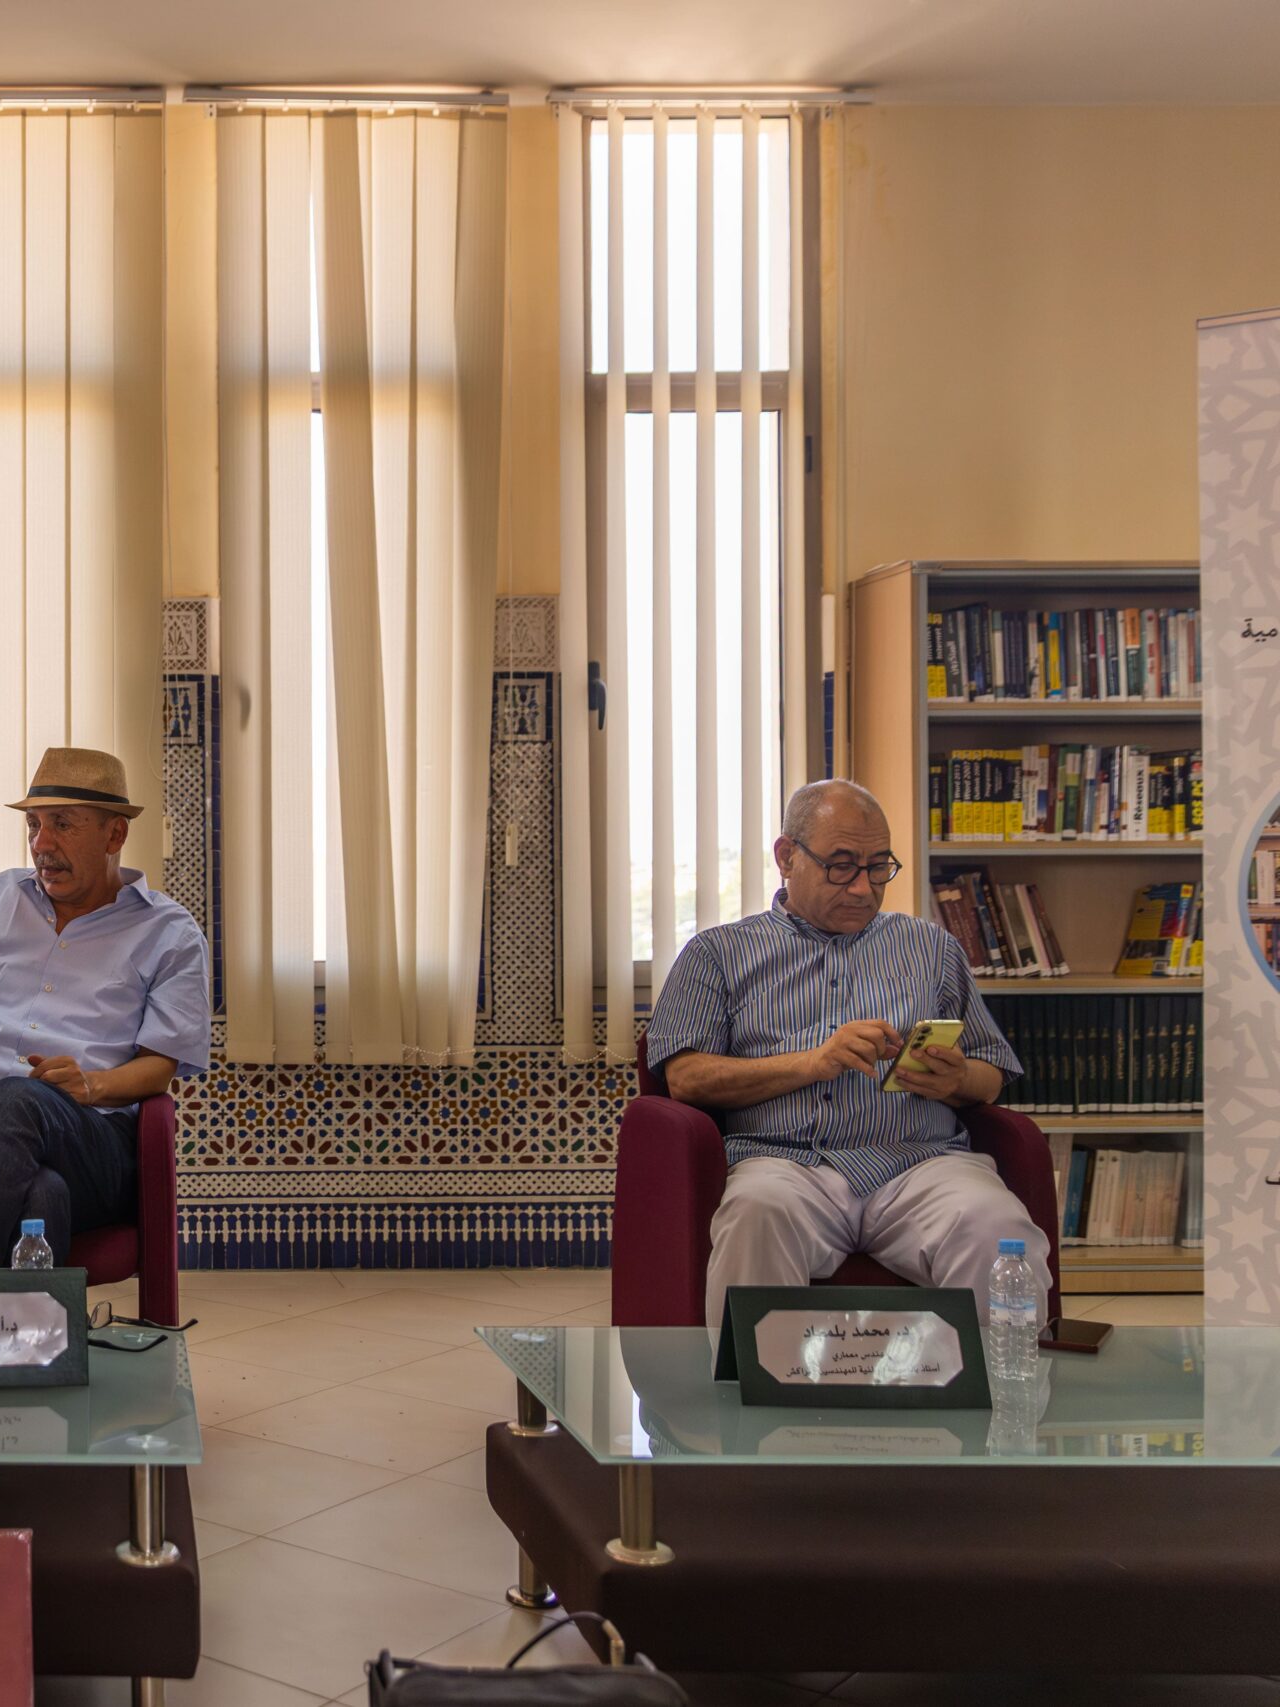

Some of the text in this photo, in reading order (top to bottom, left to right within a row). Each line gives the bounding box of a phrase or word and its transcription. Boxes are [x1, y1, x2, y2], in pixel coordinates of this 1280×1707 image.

[964, 780, 972, 800] Word
[1191, 800, 1204, 825] SOS
[852, 1326, 890, 1337] محمد
[832, 1351, 859, 1362] معماري
